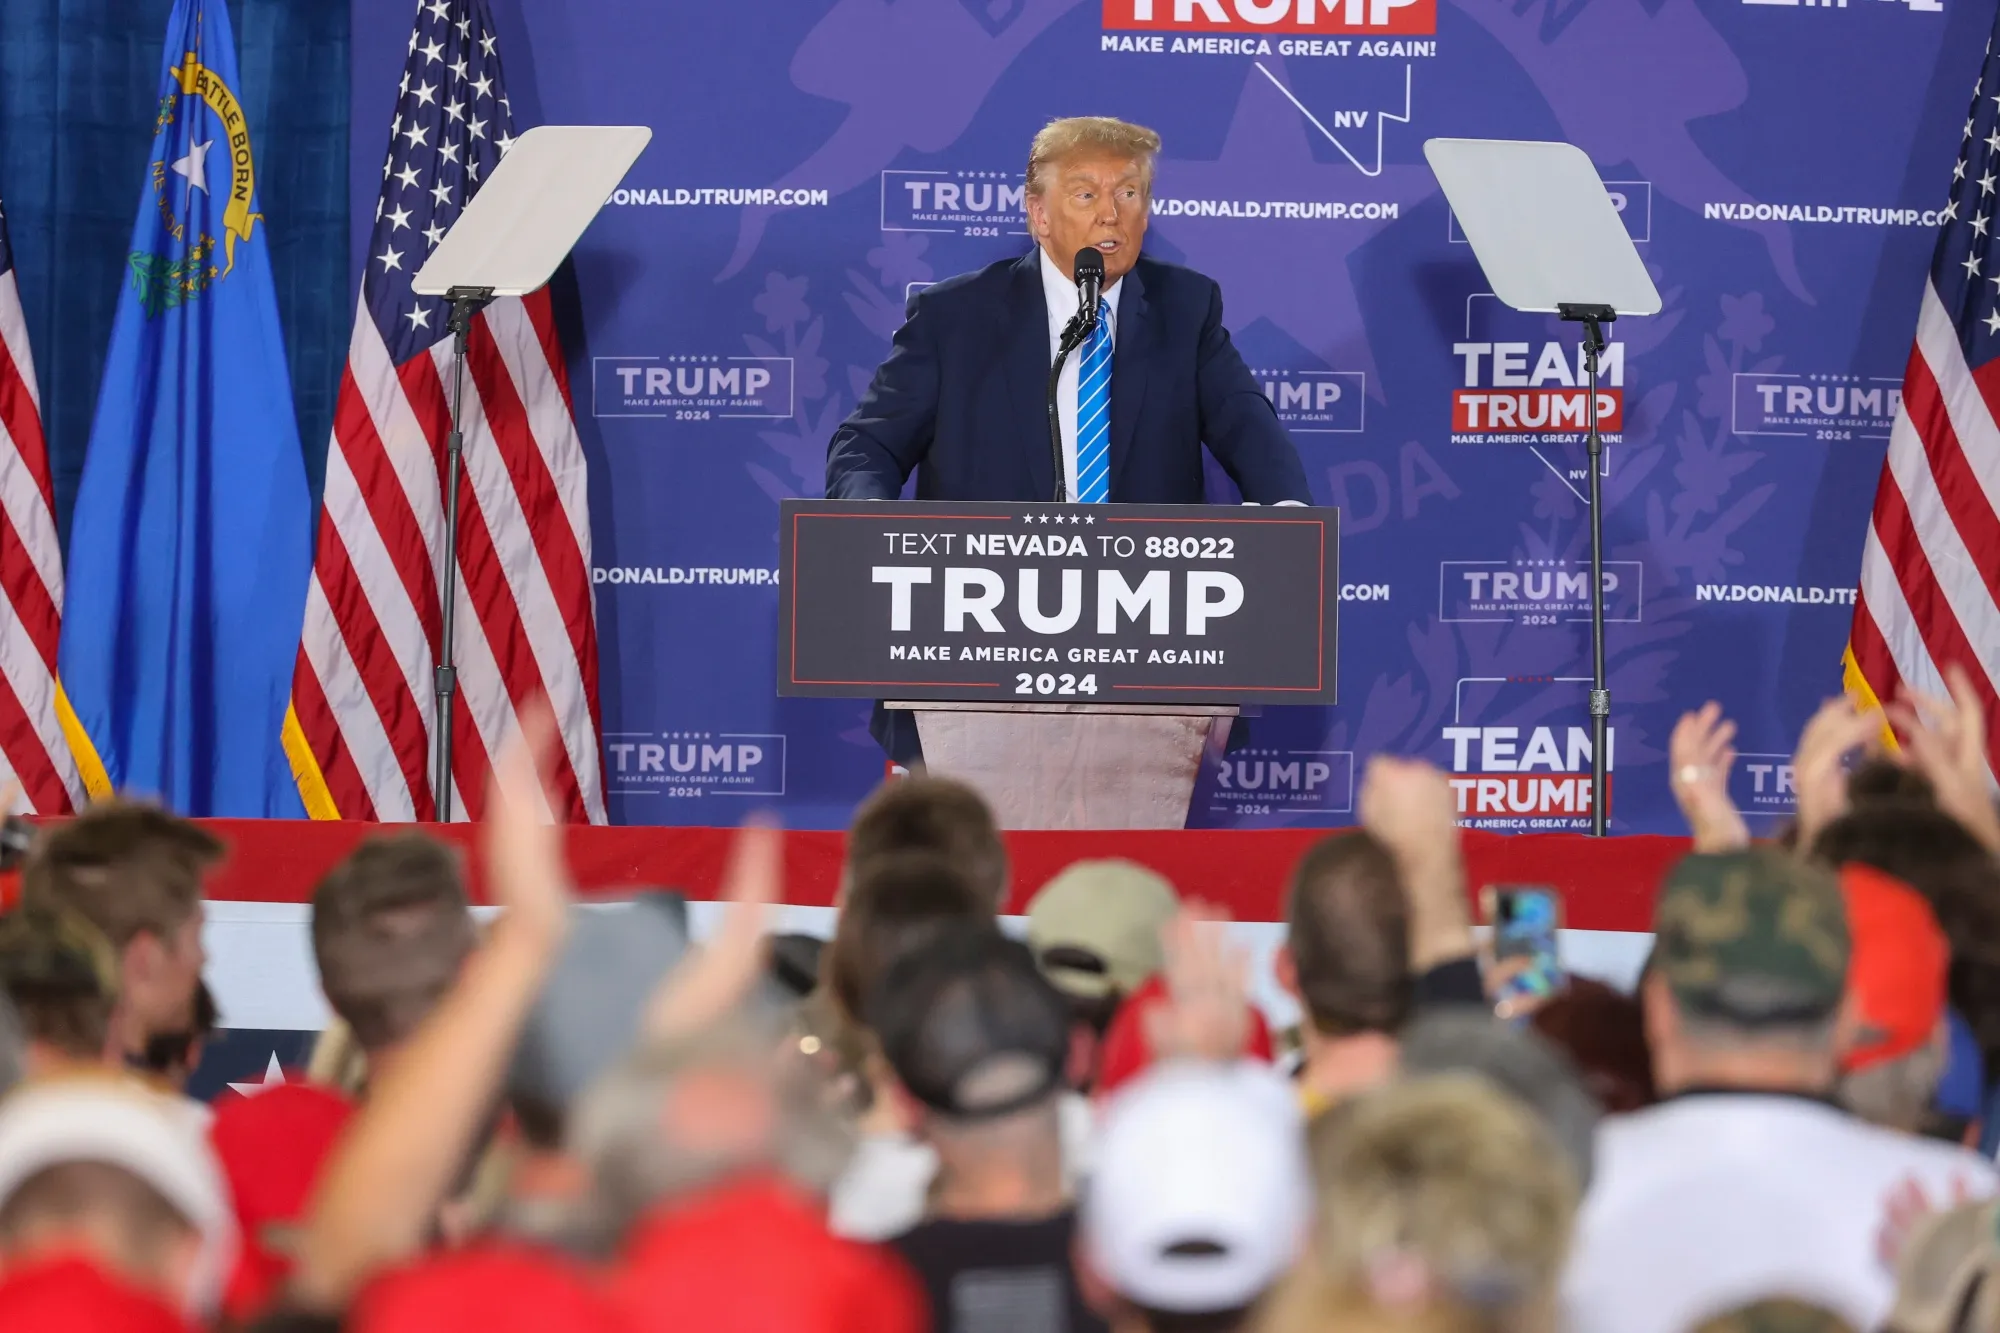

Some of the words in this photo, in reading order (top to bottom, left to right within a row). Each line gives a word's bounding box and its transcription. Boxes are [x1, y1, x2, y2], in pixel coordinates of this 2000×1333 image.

[1101, 35, 1164, 53] MAKE
[1170, 37, 1272, 55] AMERICA
[1278, 39, 1352, 56] GREAT
[1358, 41, 1436, 57] AGAIN!
[1334, 111, 1368, 128] NV
[196, 70, 240, 130] BATTLE
[232, 131, 250, 202] BORN
[912, 213, 938, 221] MAKE
[941, 214, 983, 223] AMERICA
[986, 215, 1015, 223] GREAT
[964, 227, 999, 237] 2024
[1453, 342, 1625, 387] TEAM
[616, 367, 771, 396] TRUMP
[730, 399, 763, 407] AGAIN!
[675, 410, 711, 421] 2024
[1459, 394, 1617, 428] TRUMP
[1300, 413, 1334, 421] AGAIN!
[1764, 416, 1790, 424] MAKE
[1793, 417, 1835, 426] AMERICA
[1838, 418, 1868, 427] GREAT
[1451, 435, 1484, 443] MAKE
[1486, 434, 1538, 443] AMERICA
[1541, 434, 1579, 443] GREAT
[1816, 429, 1851, 440] 2024
[1569, 470, 1587, 479] NV
[883, 532, 957, 555] TEXT
[966, 534, 1088, 557] NEVADA
[1096, 535, 1136, 558] TO
[1144, 536, 1235, 559] 88022
[593, 567, 779, 585] DONALDJTRUMP.
[871, 566, 1245, 636] TRUMP
[1470, 603, 1497, 611] MAKE
[1499, 603, 1541, 611] AMERICA
[1544, 603, 1574, 611] GREAT
[1522, 615, 1557, 625] 2024
[889, 645, 951, 662] MAKE
[959, 646, 1060, 663] AMERICA
[1067, 648, 1139, 664] GREAT
[1147, 649, 1225, 665] AGAIN!
[1015, 672, 1098, 695] 2024
[1442, 726, 1615, 772] TEAM
[609, 743, 763, 773] TRUMP
[617, 775, 643, 783] MAKE
[645, 775, 687, 784] AMERICA
[689, 776, 719, 784] GREAT
[722, 776, 755, 784] AGAIN!
[668, 787, 703, 798] 2024
[1213, 791, 1254, 800] AMERICA
[1257, 792, 1287, 800] GREAT
[1290, 793, 1322, 801] AGAIN!
[1753, 796, 1780, 804] MAKE
[1236, 804, 1270, 815] 2024
[1475, 818, 1527, 829] AMERICA
[1530, 818, 1567, 828] GREAT
